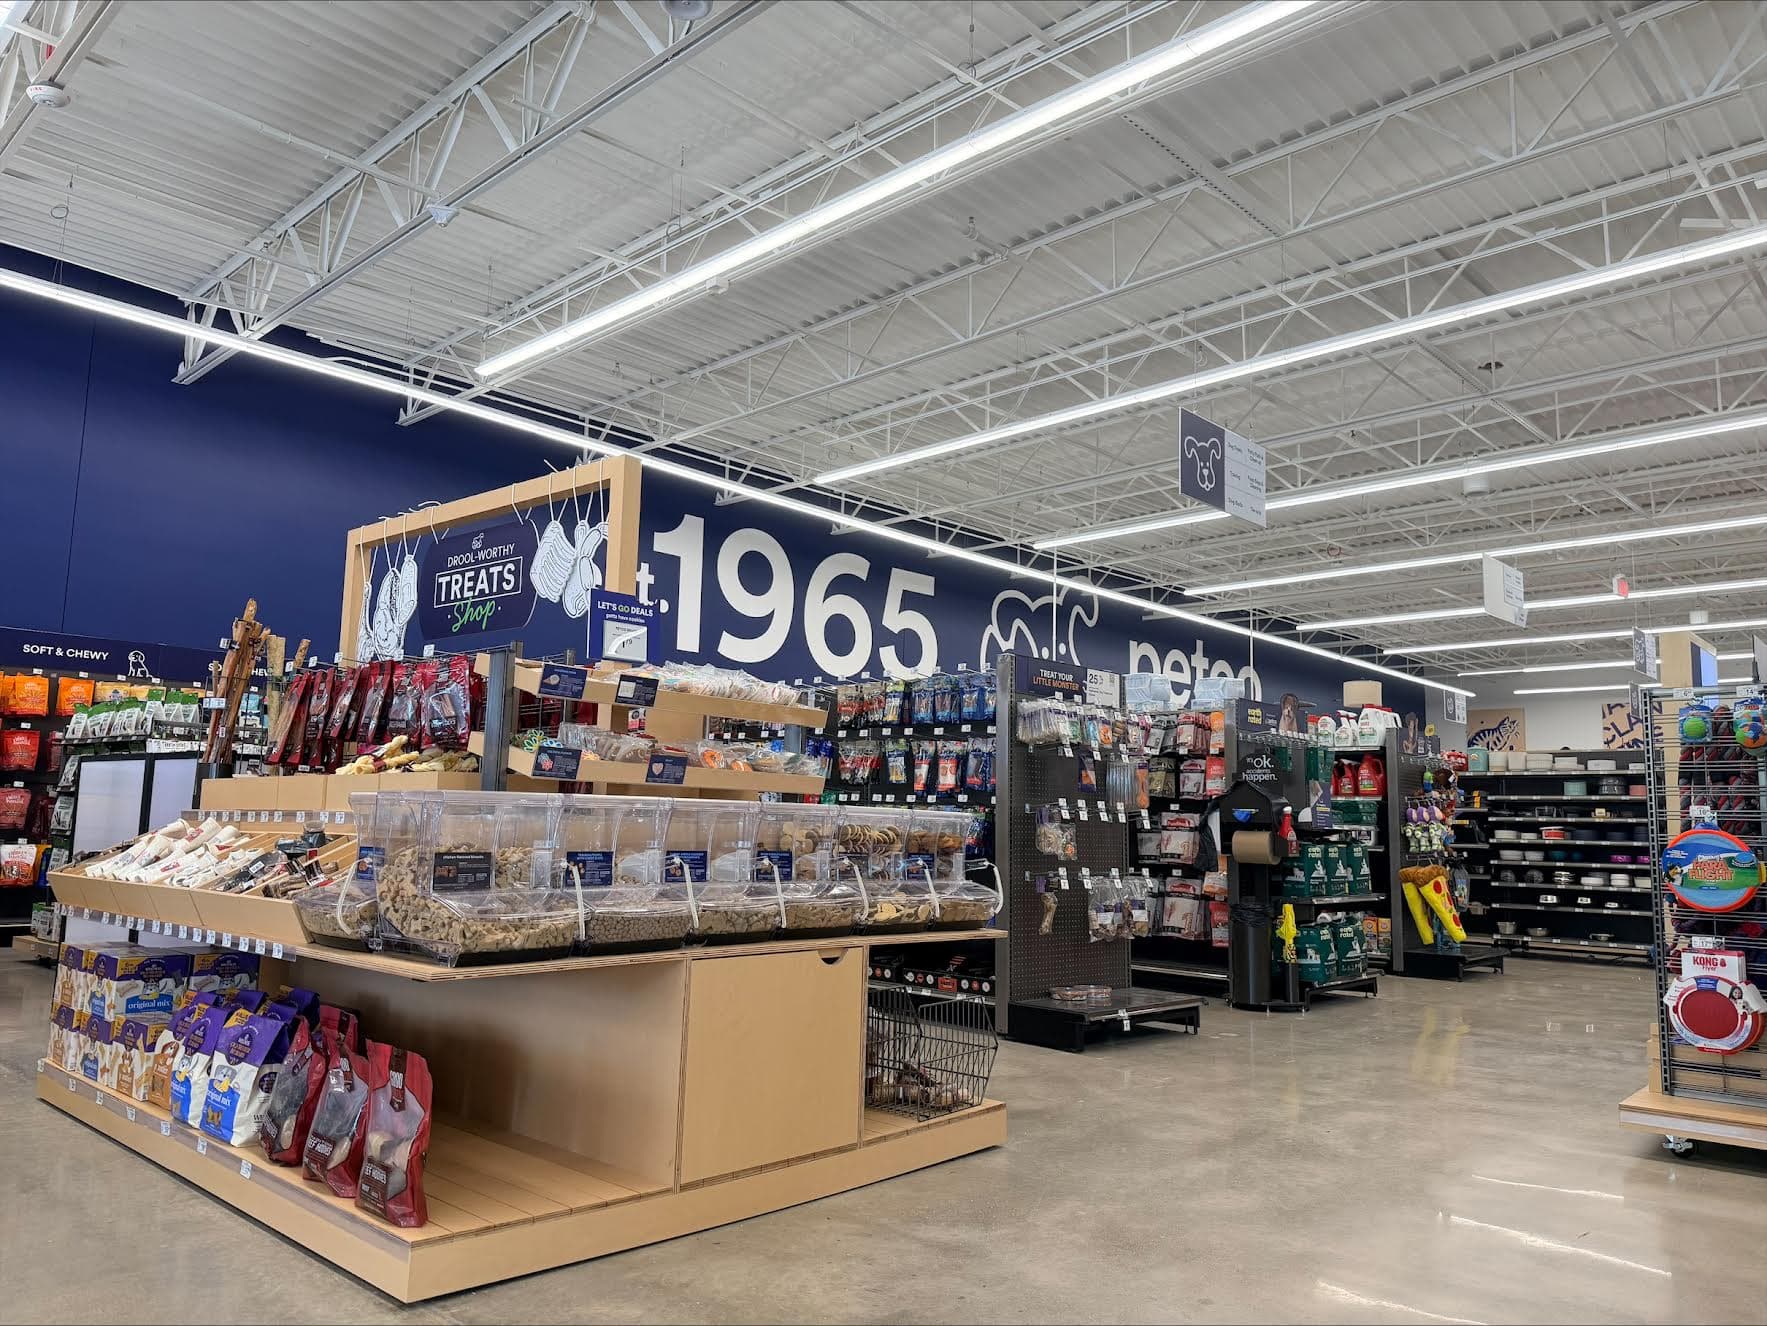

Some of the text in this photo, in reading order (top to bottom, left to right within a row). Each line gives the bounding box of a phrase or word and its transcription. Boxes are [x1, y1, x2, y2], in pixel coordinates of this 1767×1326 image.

[447, 543, 516, 568] DROOL-WORTHY
[438, 563, 516, 602] TREATS
[653, 513, 938, 681] 1965
[451, 597, 496, 633] Shop
[597, 601, 654, 617] LET'S GO DEALS
[23, 644, 109, 661] SOFT & CHEWY
[1040, 669, 1073, 682] TREAT YOUR
[1033, 676, 1080, 691] LITTLE MONSTER
[1253, 755, 1274, 768] ok.
[1242, 771, 1278, 782] happen.
[1693, 860, 1728, 871] PARA
[1688, 868, 1734, 880] FLIGHT
[1692, 955, 1719, 967] KONG
[128, 999, 170, 1010] original mix
